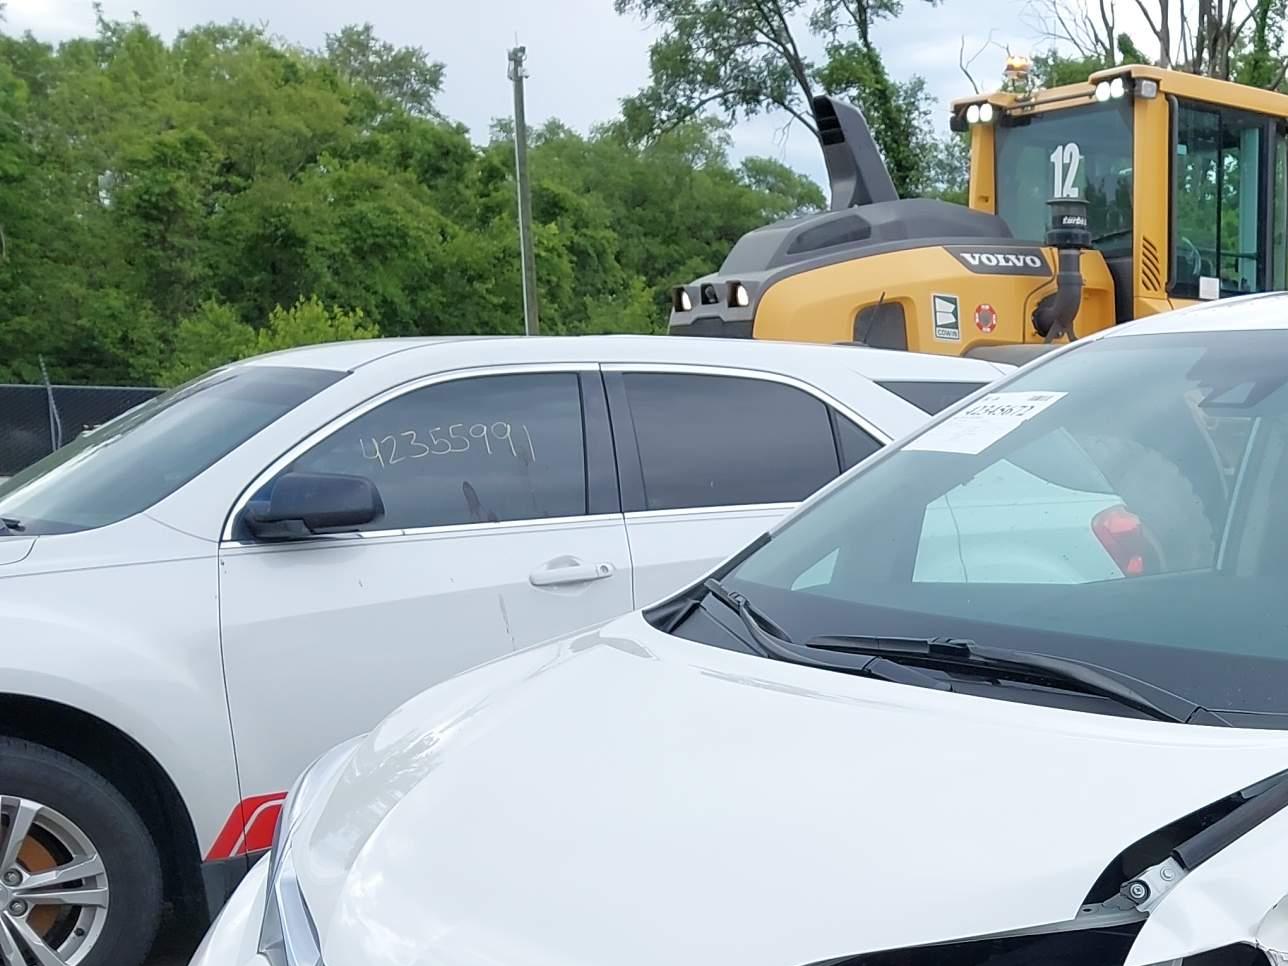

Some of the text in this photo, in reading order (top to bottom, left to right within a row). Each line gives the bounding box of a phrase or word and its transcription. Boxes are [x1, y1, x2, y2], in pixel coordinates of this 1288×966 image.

[1050, 143, 1080, 198] 12
[960, 253, 1042, 267] VOLVO
[359, 421, 536, 468] 42355991
